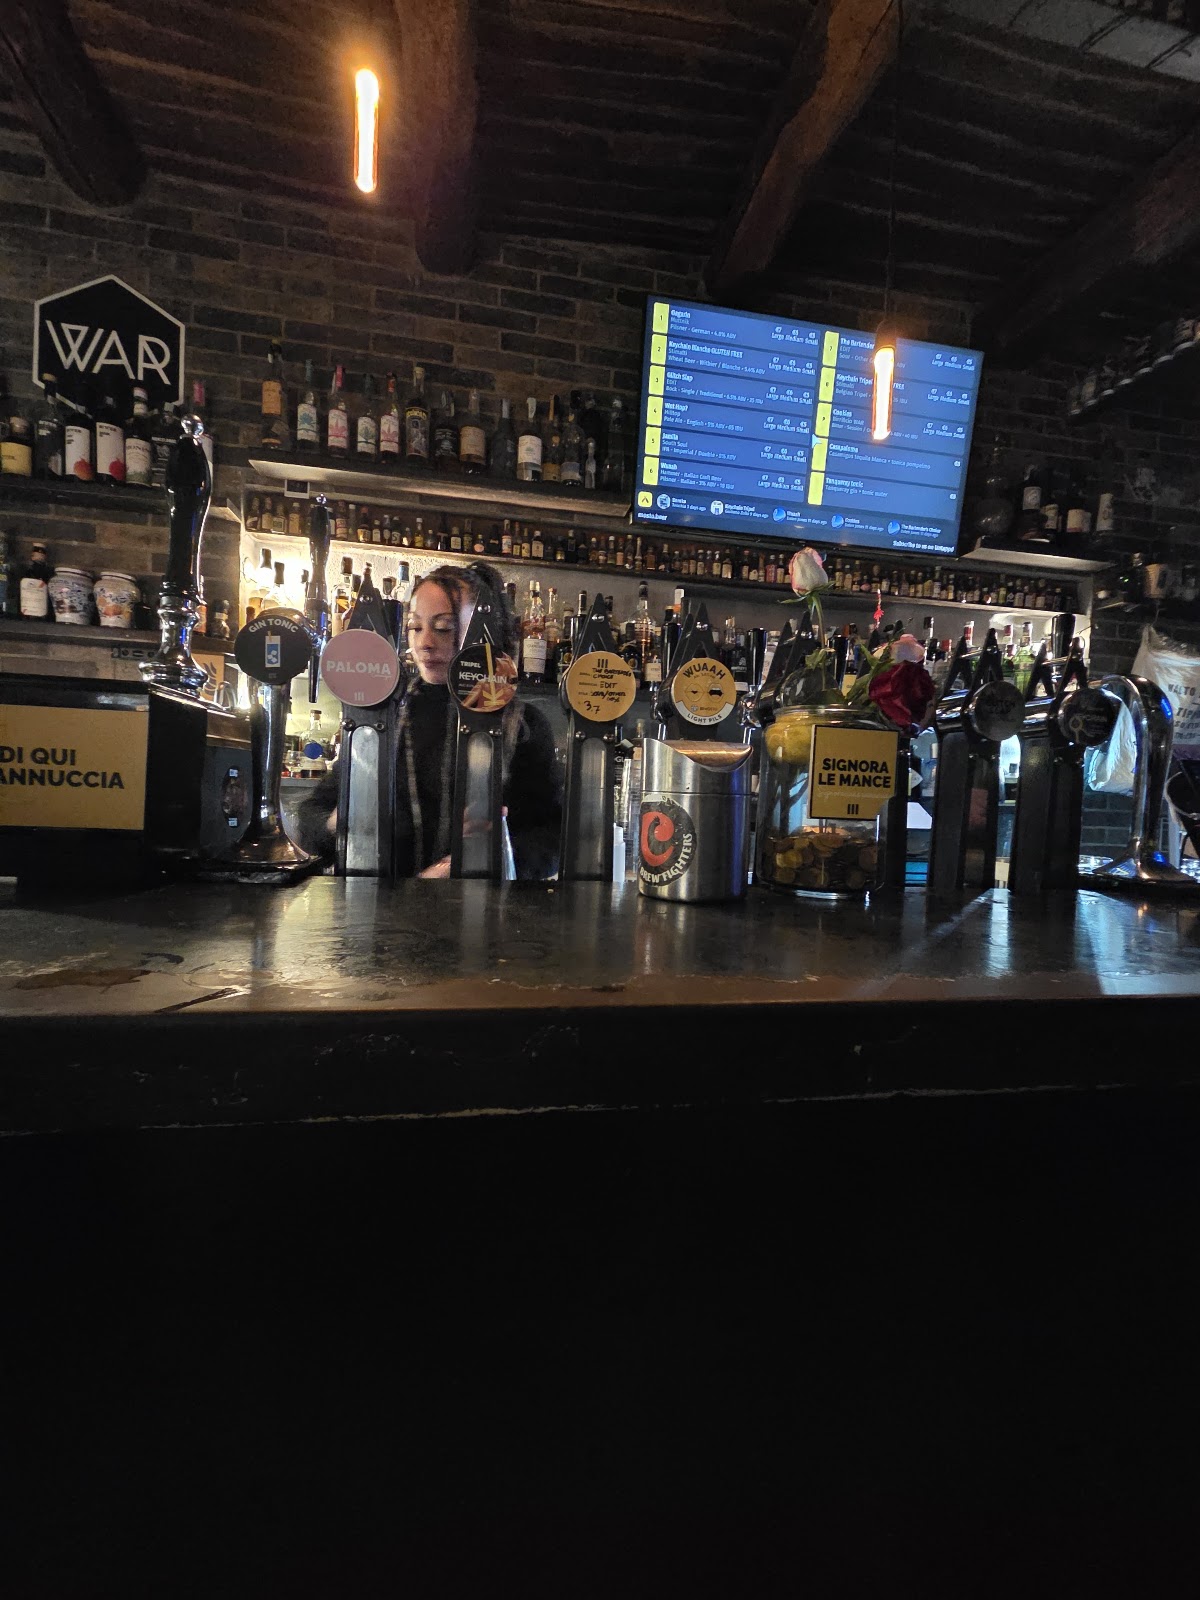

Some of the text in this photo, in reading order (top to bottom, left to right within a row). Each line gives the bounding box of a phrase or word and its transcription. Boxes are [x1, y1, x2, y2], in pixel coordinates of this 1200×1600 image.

[691, 327, 710, 335] German
[772, 333, 784, 341] Large
[785, 334, 804, 343] Medium
[851, 340, 874, 349] Bartender
[46, 319, 171, 385] WAR
[711, 347, 730, 356] GLUTEN
[731, 350, 743, 358] FREE
[769, 363, 781, 371] Large
[782, 365, 801, 373] Medium
[836, 388, 853, 396] Belgian
[766, 393, 812, 405] Large Medium Small
[928, 394, 939, 402] Large
[687, 419, 704, 427] English
[764, 423, 809, 434] Large Medium Small
[923, 428, 935, 436] Large
[771, 482, 790, 490] Medium
[248, 618, 299, 633] GIN TONIC
[326, 660, 391, 675] PALOMA
[683, 663, 726, 680] WUAAH
[459, 671, 507, 684] KEYCHAIN
[687, 713, 722, 723] LIGHT PILS
[30, 747, 76, 766] QUI
[822, 757, 889, 773] SIGNORA
[818, 773, 891, 788] LE MANCE
[639, 833, 693, 884] BREW FIGHTERS
